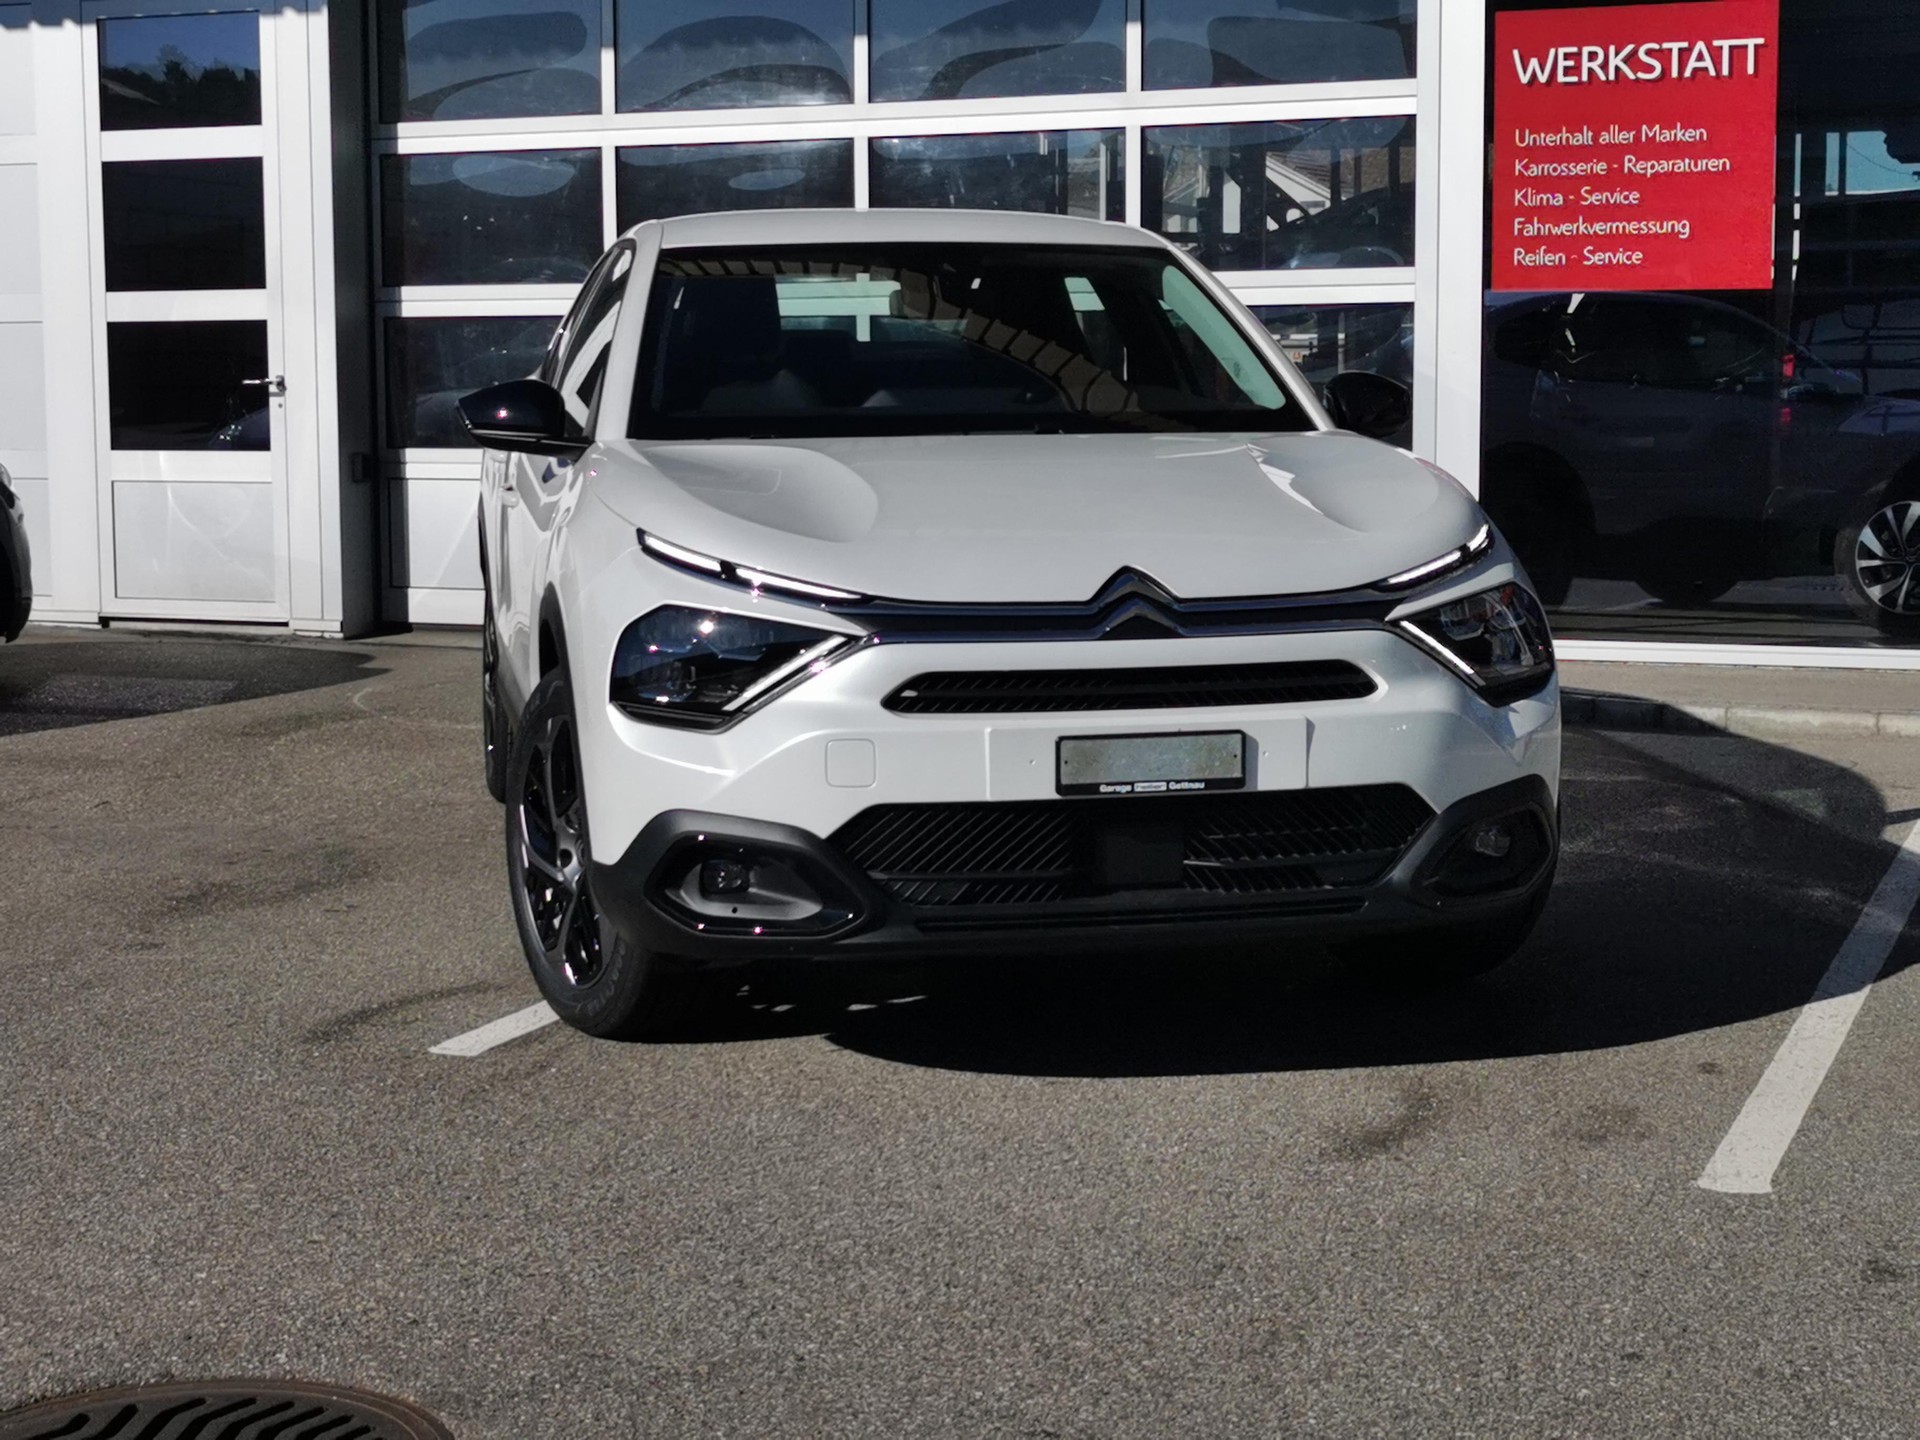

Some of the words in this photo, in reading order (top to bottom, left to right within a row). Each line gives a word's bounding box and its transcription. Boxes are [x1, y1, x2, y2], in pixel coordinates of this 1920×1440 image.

[1512, 37, 1765, 85] WERKSTATT
[1515, 125, 1594, 147] Unterhalt
[1599, 124, 1636, 144] aller
[1641, 122, 1707, 143] Marken
[1514, 158, 1608, 177] Karrosserie
[1624, 155, 1731, 178] Reparaturen
[1514, 188, 1564, 207] Klima
[1580, 186, 1641, 205] Service
[1513, 216, 1691, 239] Fahrwerkvermessung
[1513, 245, 1566, 266] Reifen
[1583, 246, 1644, 265] Service
